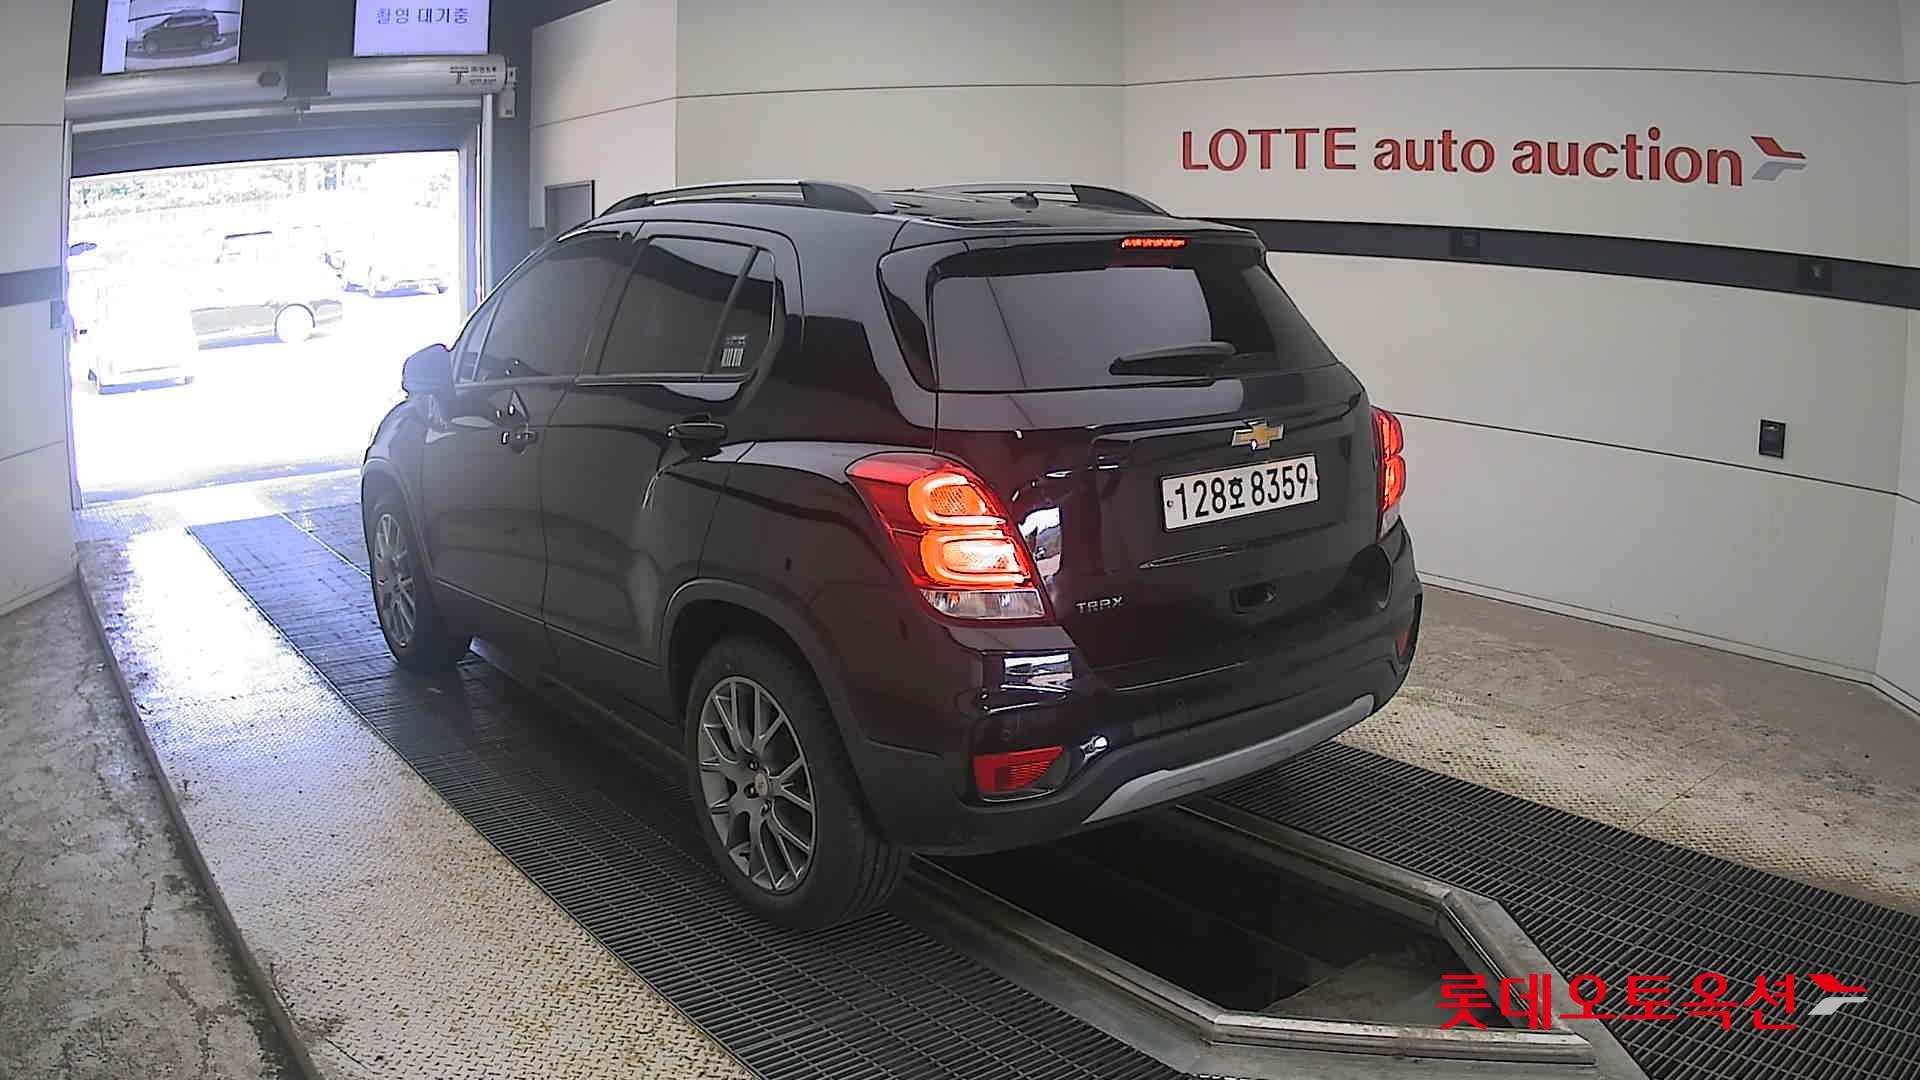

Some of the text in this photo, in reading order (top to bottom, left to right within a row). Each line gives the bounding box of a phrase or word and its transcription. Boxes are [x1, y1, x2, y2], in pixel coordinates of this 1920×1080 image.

[417, 7, 470, 25] 대기중
[1182, 126, 1744, 187] LOTTE auto auction
[1174, 462, 1309, 521] 128호 8359
